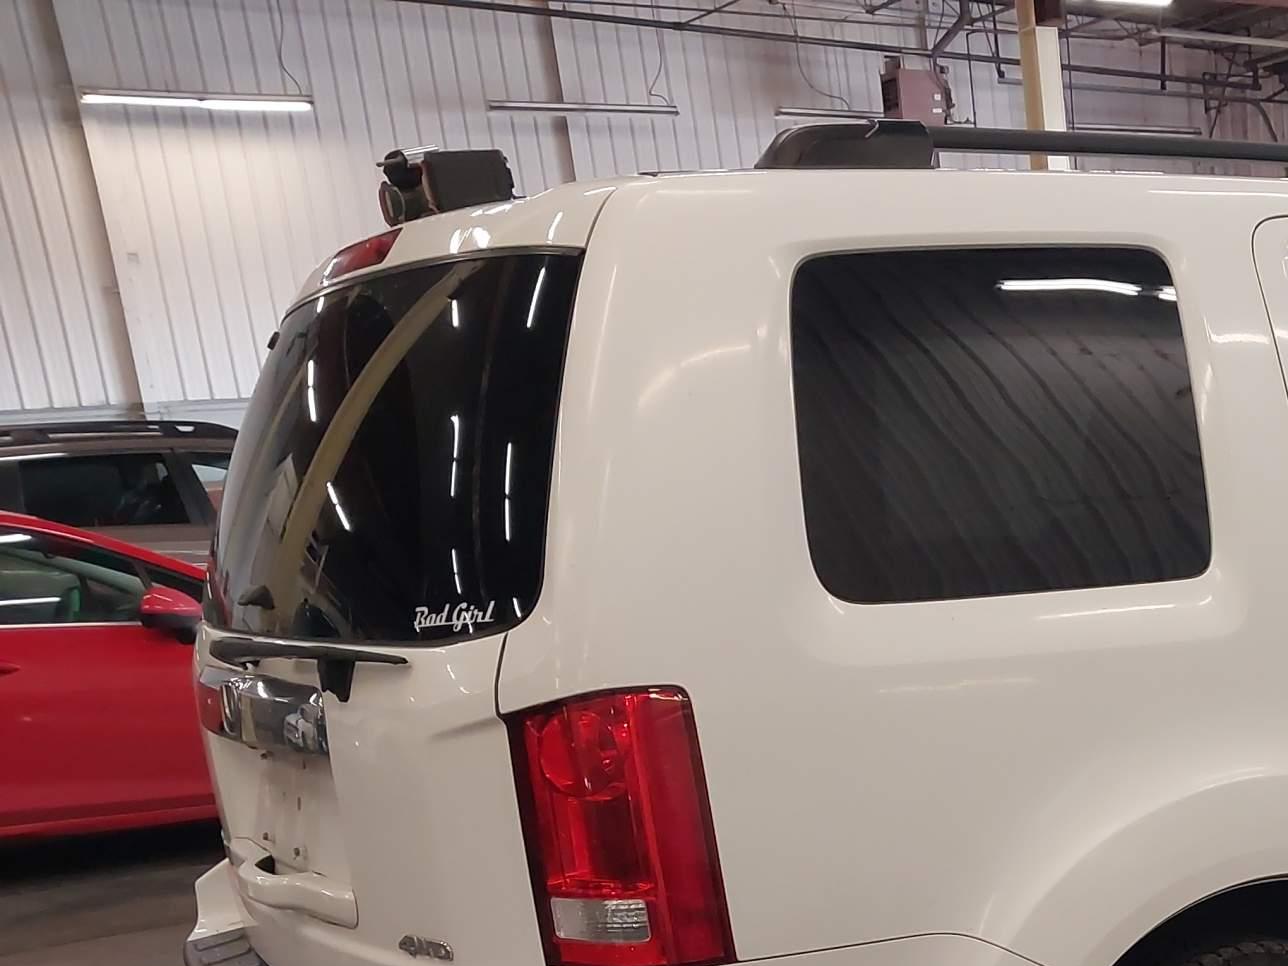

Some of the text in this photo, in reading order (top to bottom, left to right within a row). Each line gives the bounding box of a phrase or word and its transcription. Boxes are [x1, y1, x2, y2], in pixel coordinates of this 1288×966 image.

[414, 600, 495, 633] Bad Girl
[399, 935, 454, 961] 4WD
